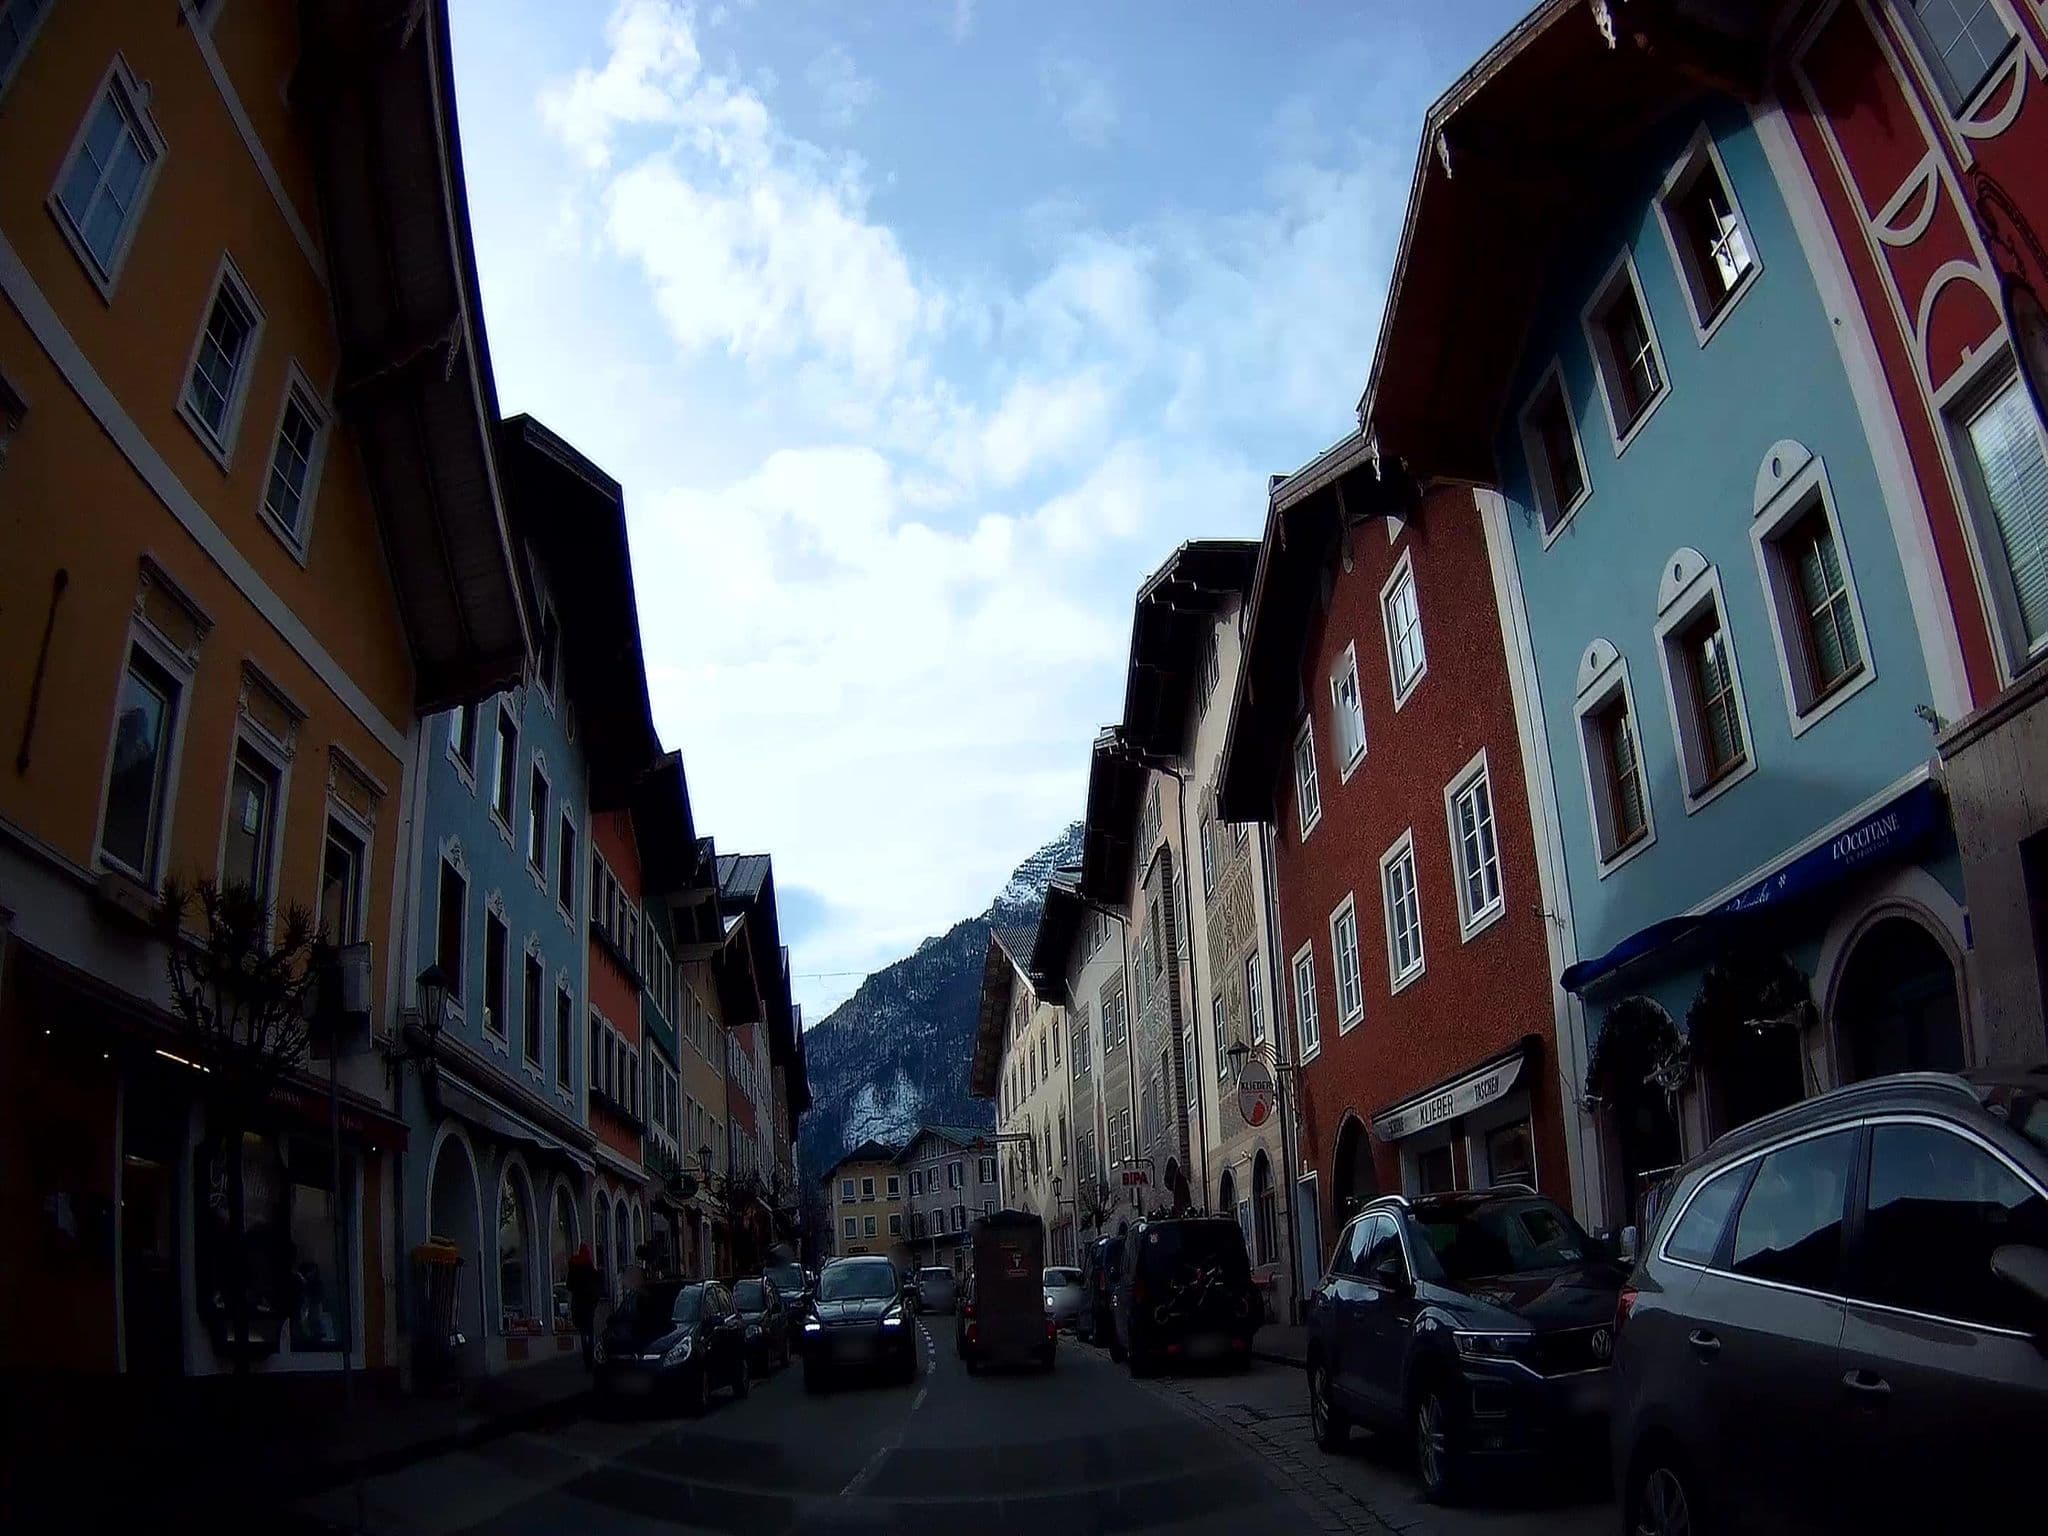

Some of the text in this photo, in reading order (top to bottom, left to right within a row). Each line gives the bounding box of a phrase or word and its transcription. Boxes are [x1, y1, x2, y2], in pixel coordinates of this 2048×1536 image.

[1833, 812, 1900, 861] L'OCCITANE
[1420, 1095, 1454, 1125] KLIEBER
[1474, 1074, 1499, 1101] TASCHEN
[1122, 1172, 1149, 1186] BIPA
